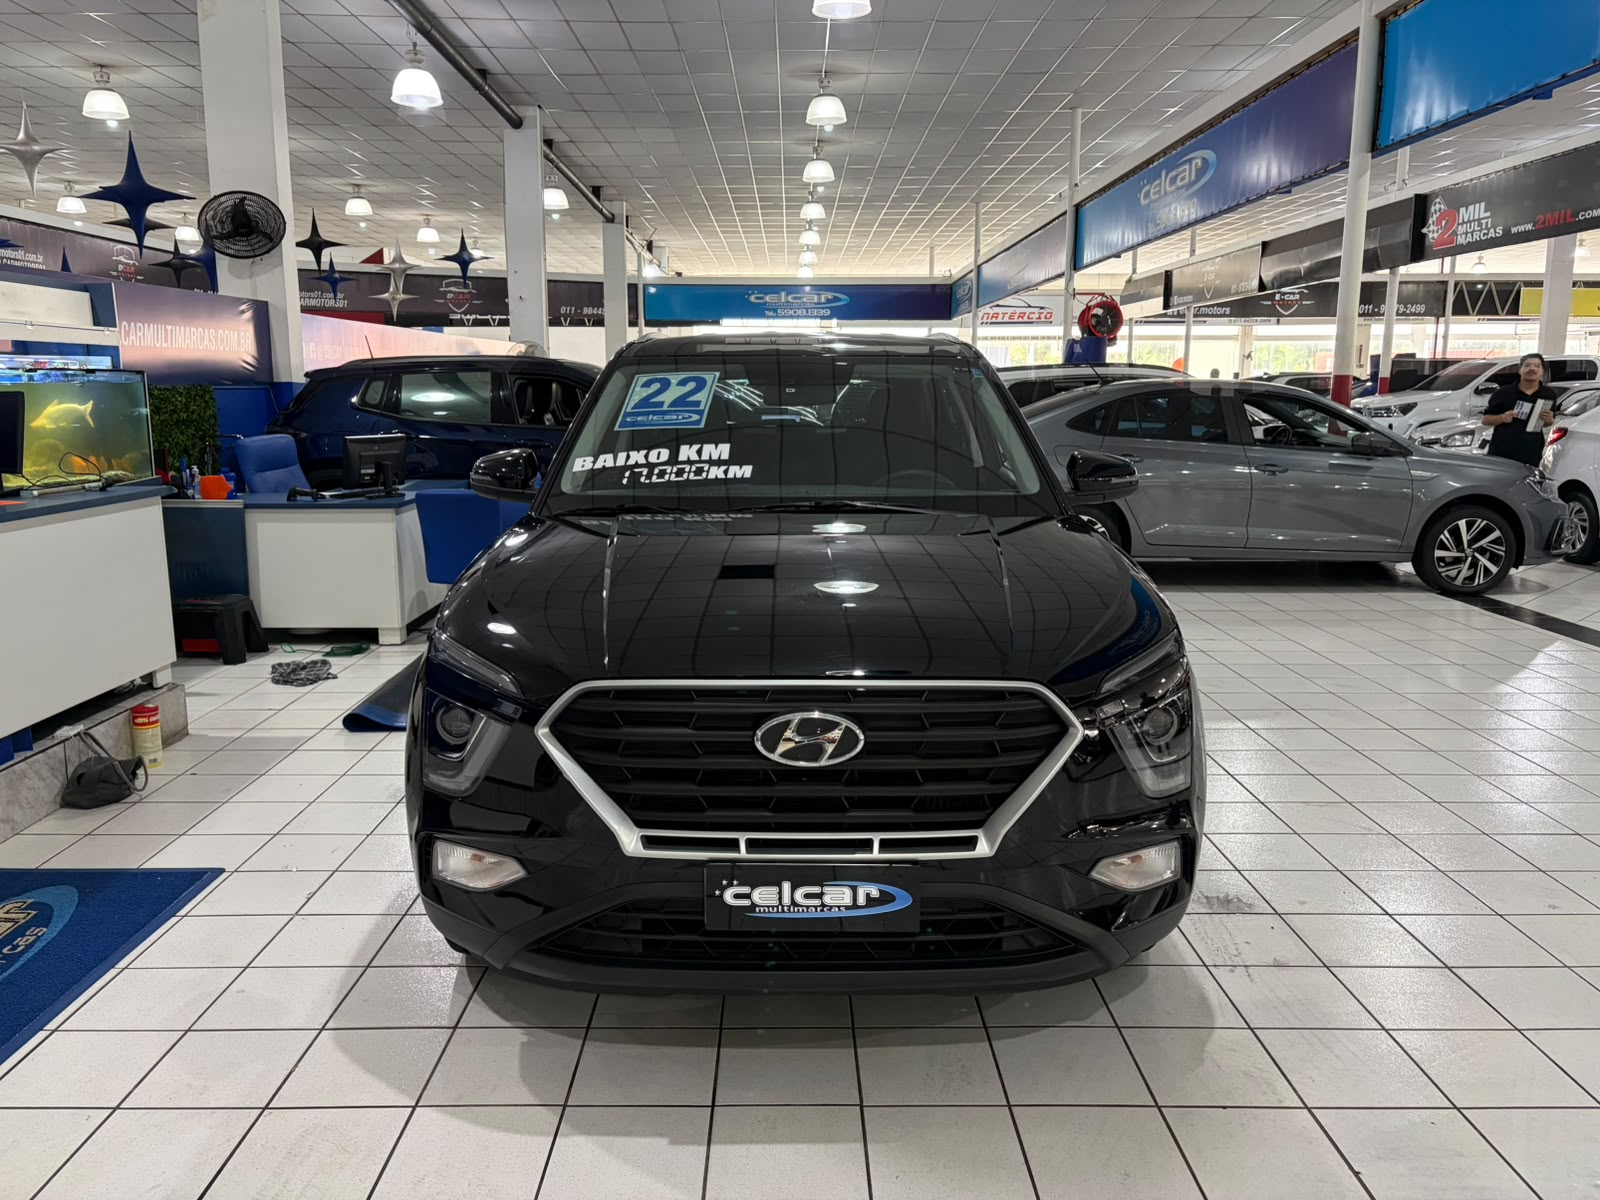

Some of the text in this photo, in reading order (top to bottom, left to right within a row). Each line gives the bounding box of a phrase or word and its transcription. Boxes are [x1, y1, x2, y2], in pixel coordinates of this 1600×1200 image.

[1140, 159, 1202, 206] celcar
[1433, 202, 1491, 250] 2 MIL
[1457, 218, 1492, 235] MULTI
[1456, 226, 1503, 245] MARCAS
[748, 291, 833, 303] celcar
[561, 306, 575, 314] 011
[1359, 304, 1372, 314] 011
[631, 375, 708, 411] 22
[626, 414, 689, 423] celcar
[572, 443, 731, 472] BAIXO KM
[722, 880, 880, 906] celcar
[755, 905, 846, 913] multimarcas
